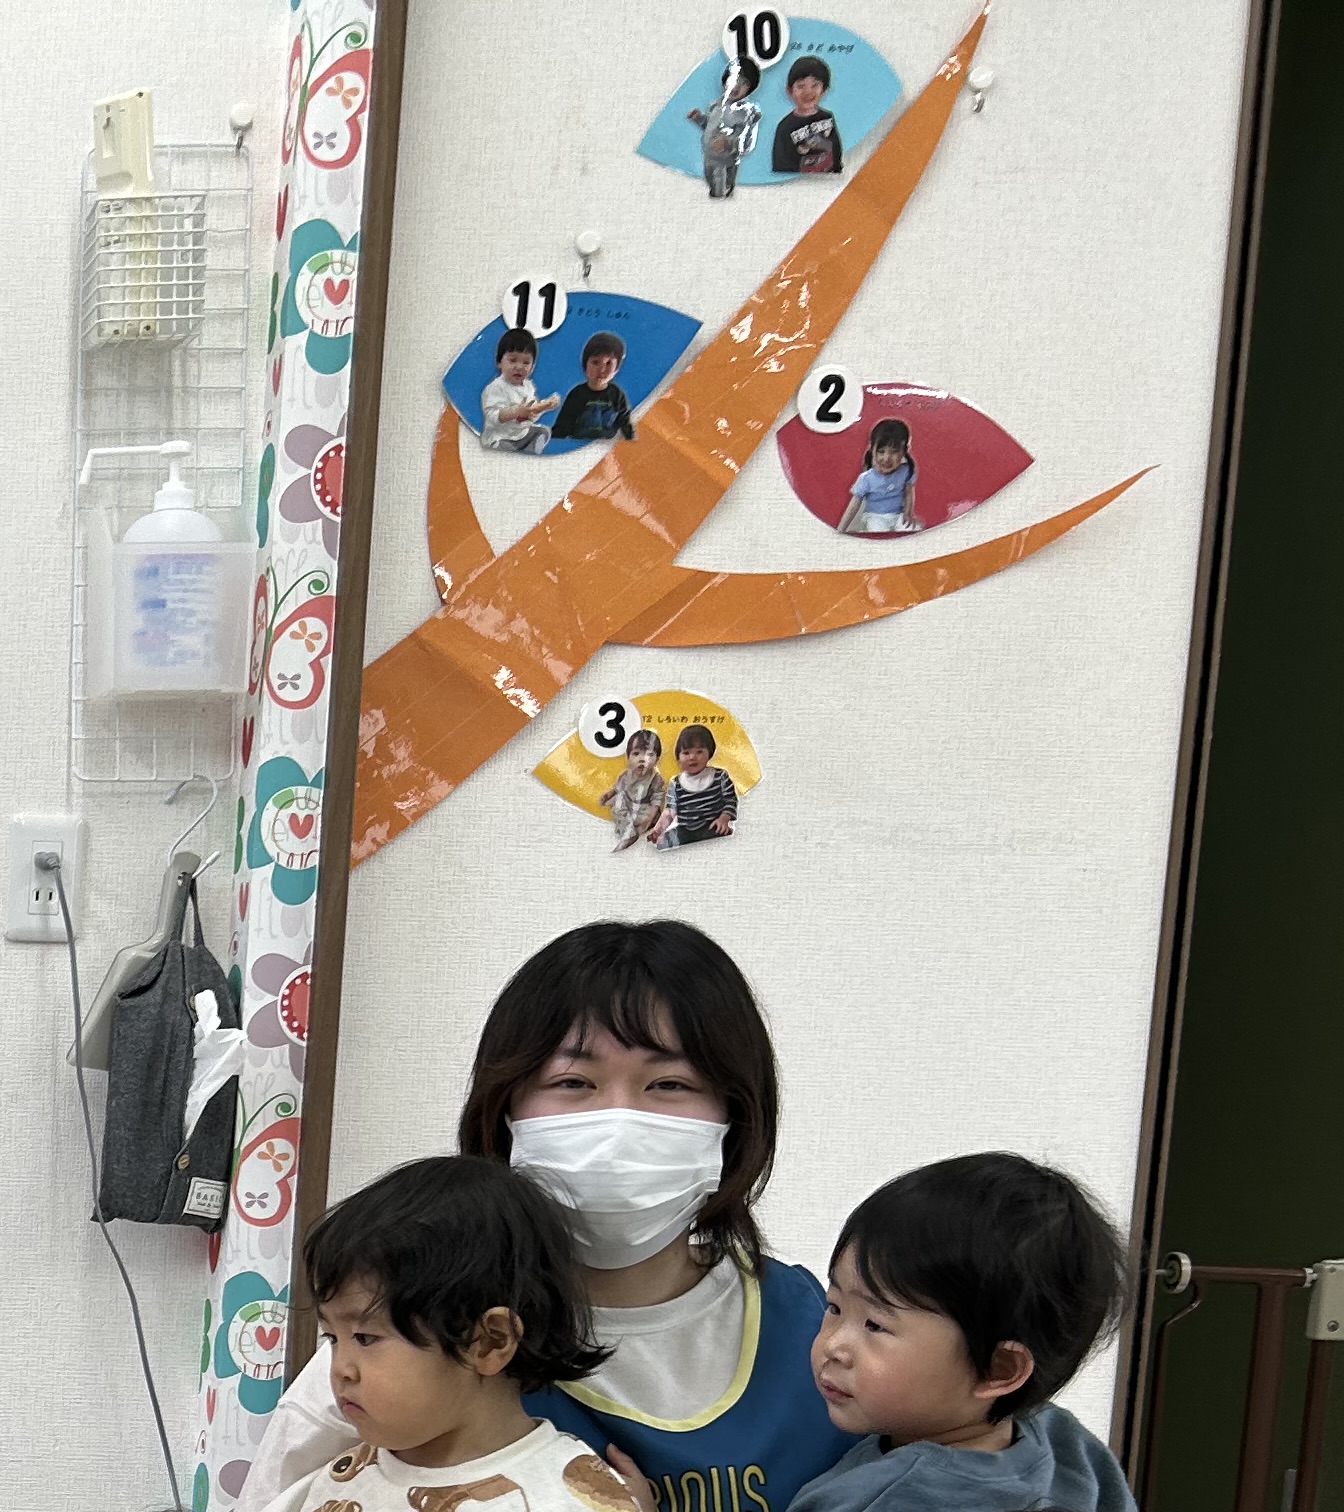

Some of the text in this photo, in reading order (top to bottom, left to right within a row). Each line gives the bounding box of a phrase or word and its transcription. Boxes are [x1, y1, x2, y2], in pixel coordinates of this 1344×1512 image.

[728, 10, 781, 60] 10
[511, 280, 557, 330] 11
[816, 374, 846, 423] 2
[594, 701, 626, 749] 3
